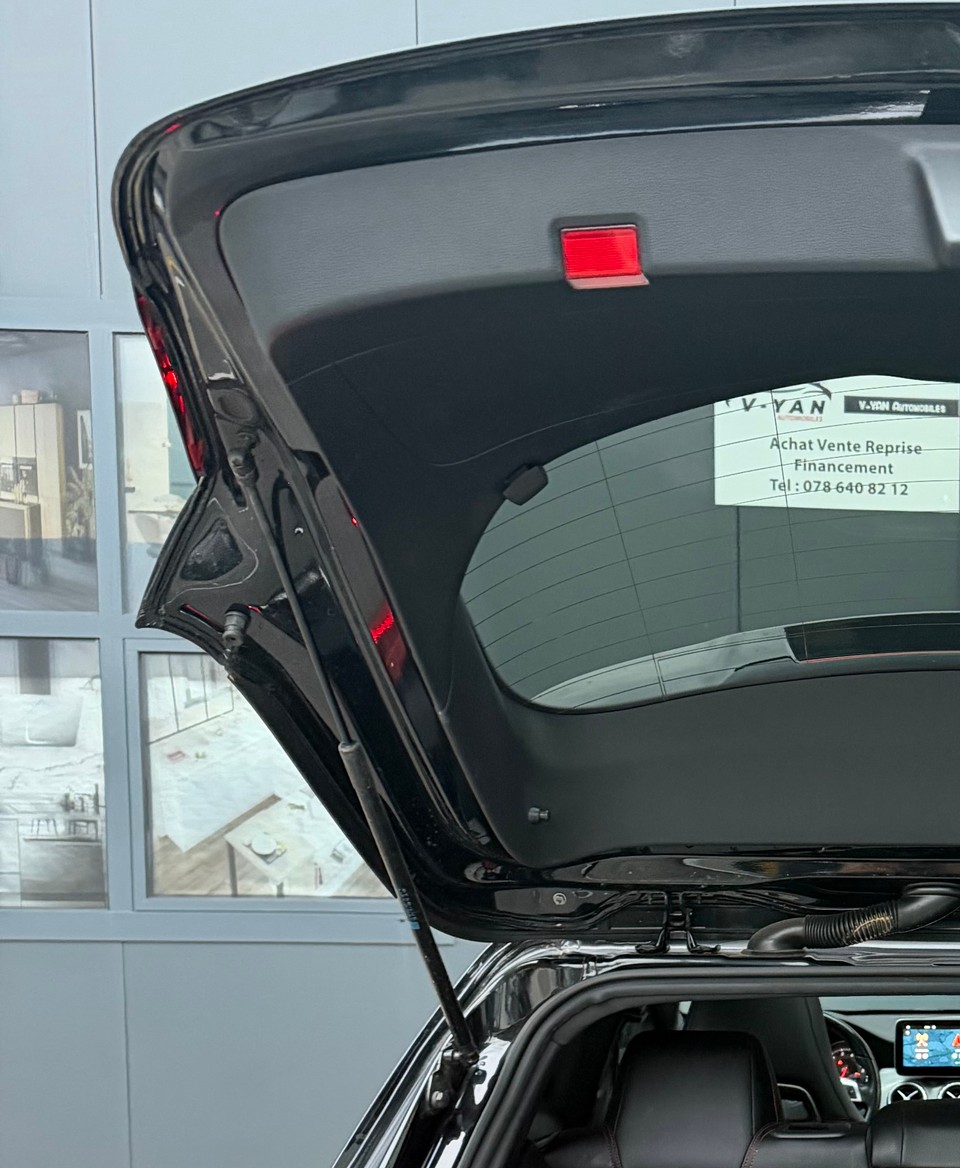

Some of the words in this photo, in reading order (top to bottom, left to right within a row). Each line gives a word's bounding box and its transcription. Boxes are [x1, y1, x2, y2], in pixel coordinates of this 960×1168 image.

[742, 398, 825, 415] V-YAN
[859, 400, 890, 411] V-YAN
[770, 437, 814, 451] Achat
[817, 439, 861, 452] Vente
[866, 441, 922, 456] Reprise
[794, 459, 894, 474] Financement
[803, 480, 832, 493] 078
[836, 481, 864, 494] 640
[868, 483, 886, 495] 82
[891, 483, 908, 495] 12
